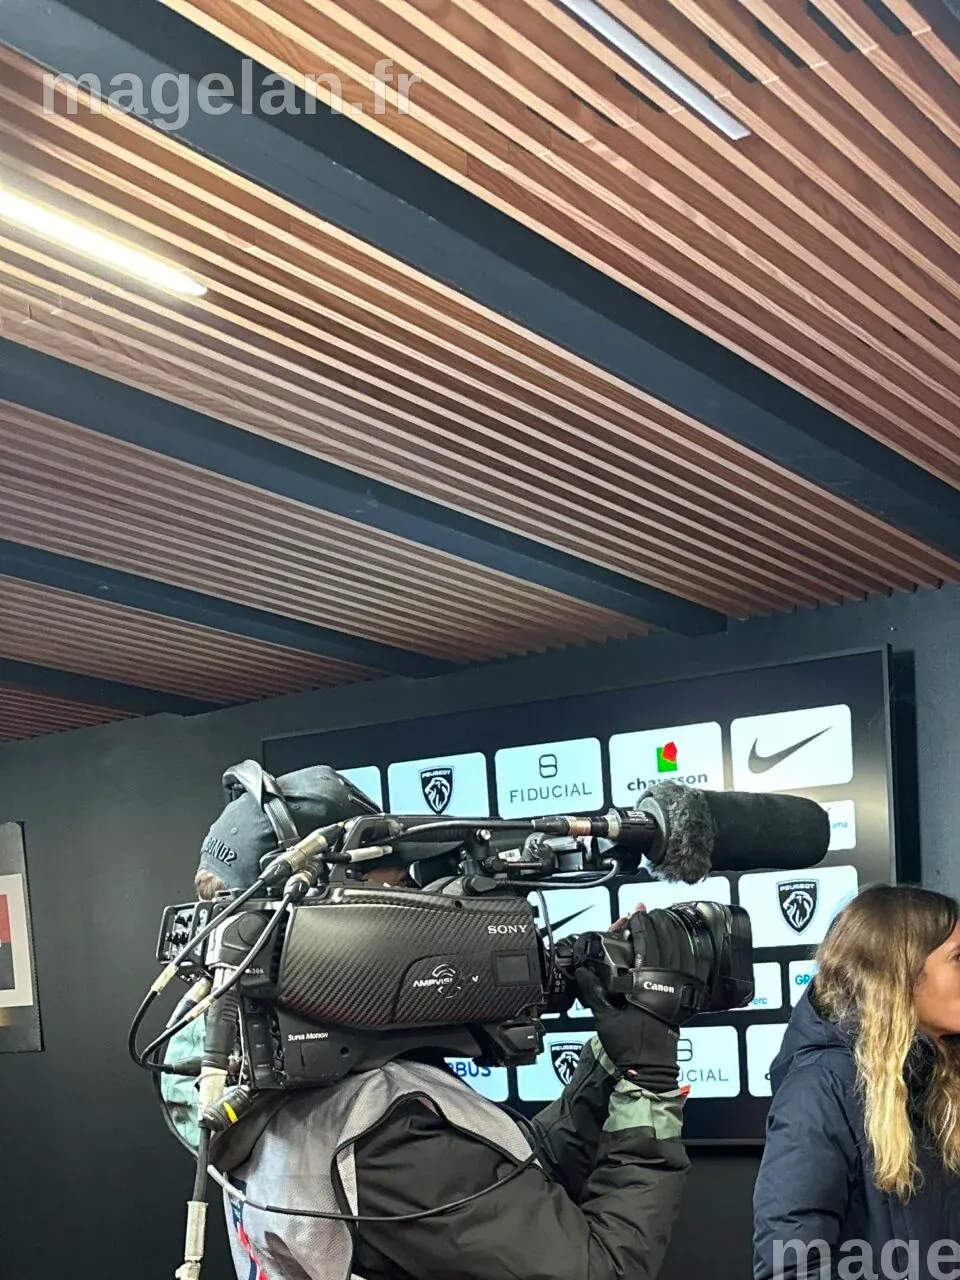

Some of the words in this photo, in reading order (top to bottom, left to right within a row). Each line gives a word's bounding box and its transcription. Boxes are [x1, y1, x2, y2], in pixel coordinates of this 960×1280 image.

[421, 769, 451, 779] PEUGEOT
[509, 782, 592, 803] FIDUCIAL
[779, 883, 816, 892] PEUGEOT
[487, 924, 528, 935] SONY
[643, 980, 675, 994] Canon
[449, 1061, 491, 1078] BUS
